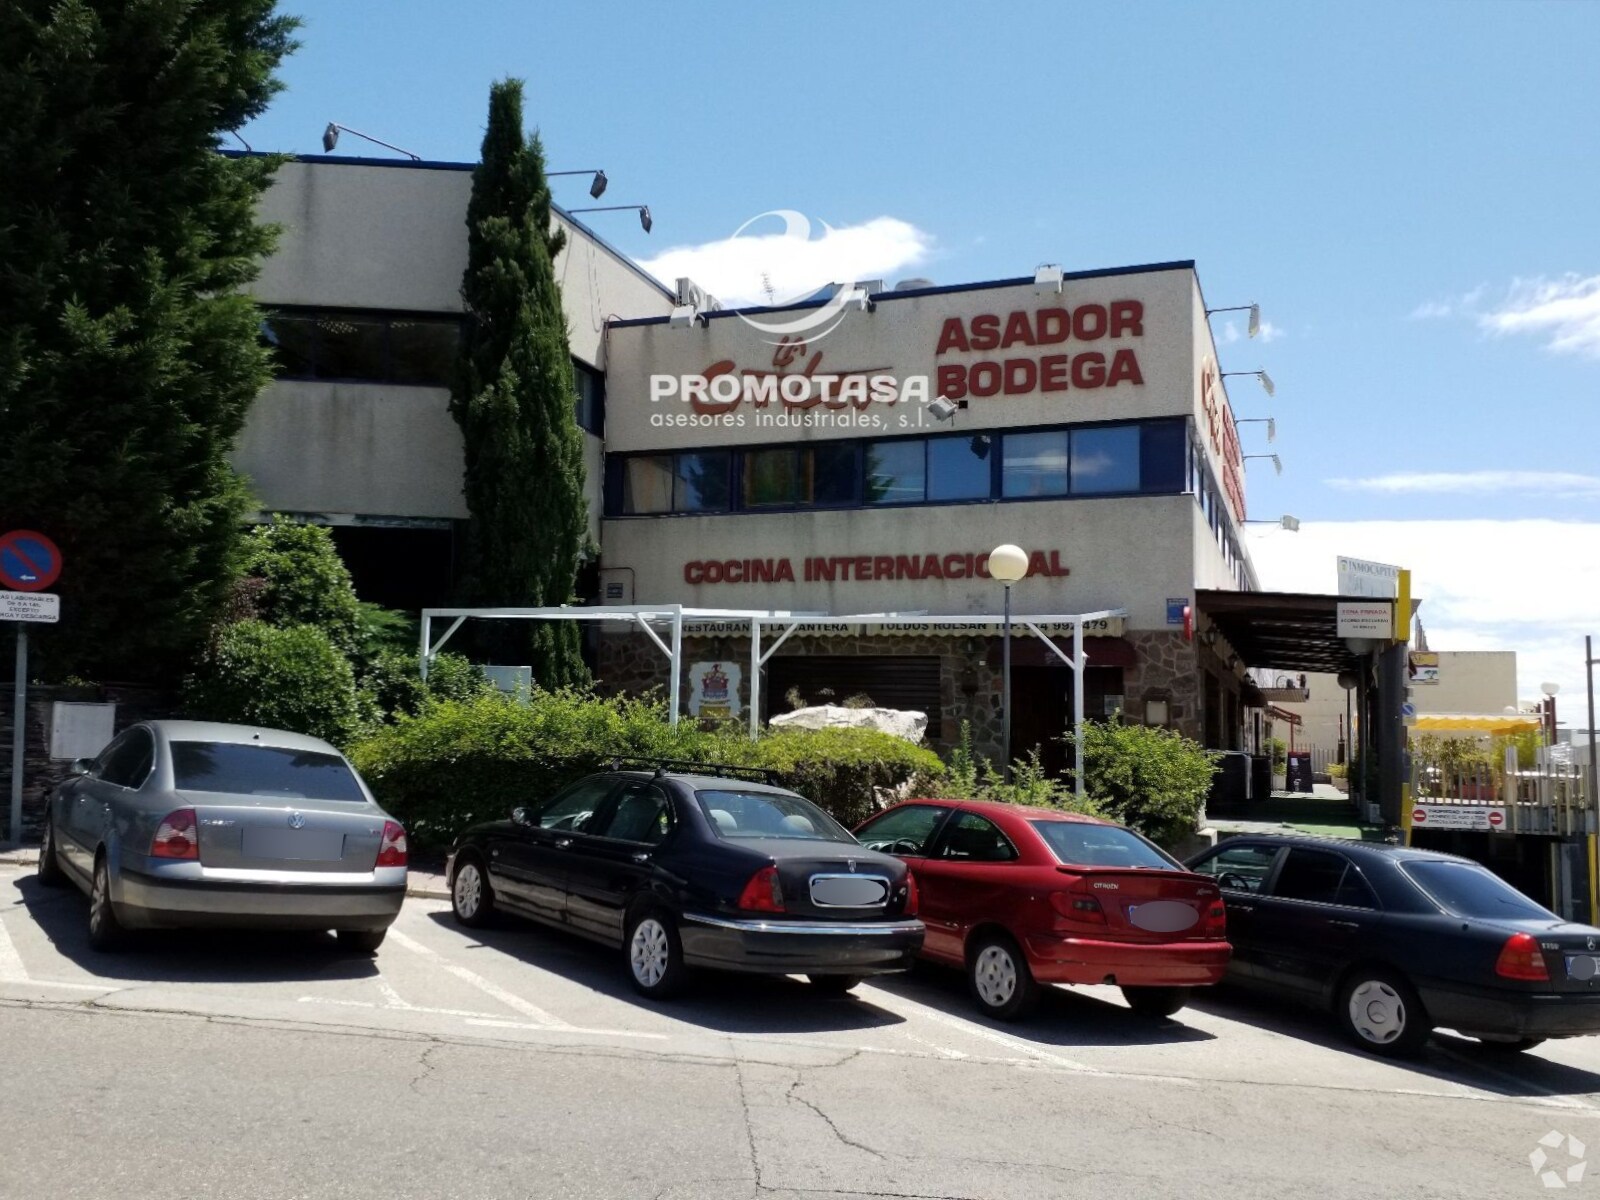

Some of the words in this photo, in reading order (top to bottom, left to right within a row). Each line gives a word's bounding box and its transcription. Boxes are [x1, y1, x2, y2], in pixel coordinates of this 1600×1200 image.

[935, 300, 1144, 355] ASADOR
[937, 349, 1144, 400] BODEGA
[683, 558, 795, 584] COCINA
[804, 550, 1070, 582] INTERNACIOAL
[682, 622, 765, 632] RESTAURANE
[770, 623, 785, 632] LA
[788, 623, 849, 632] ANTERA
[1082, 620, 1108, 630] 479
